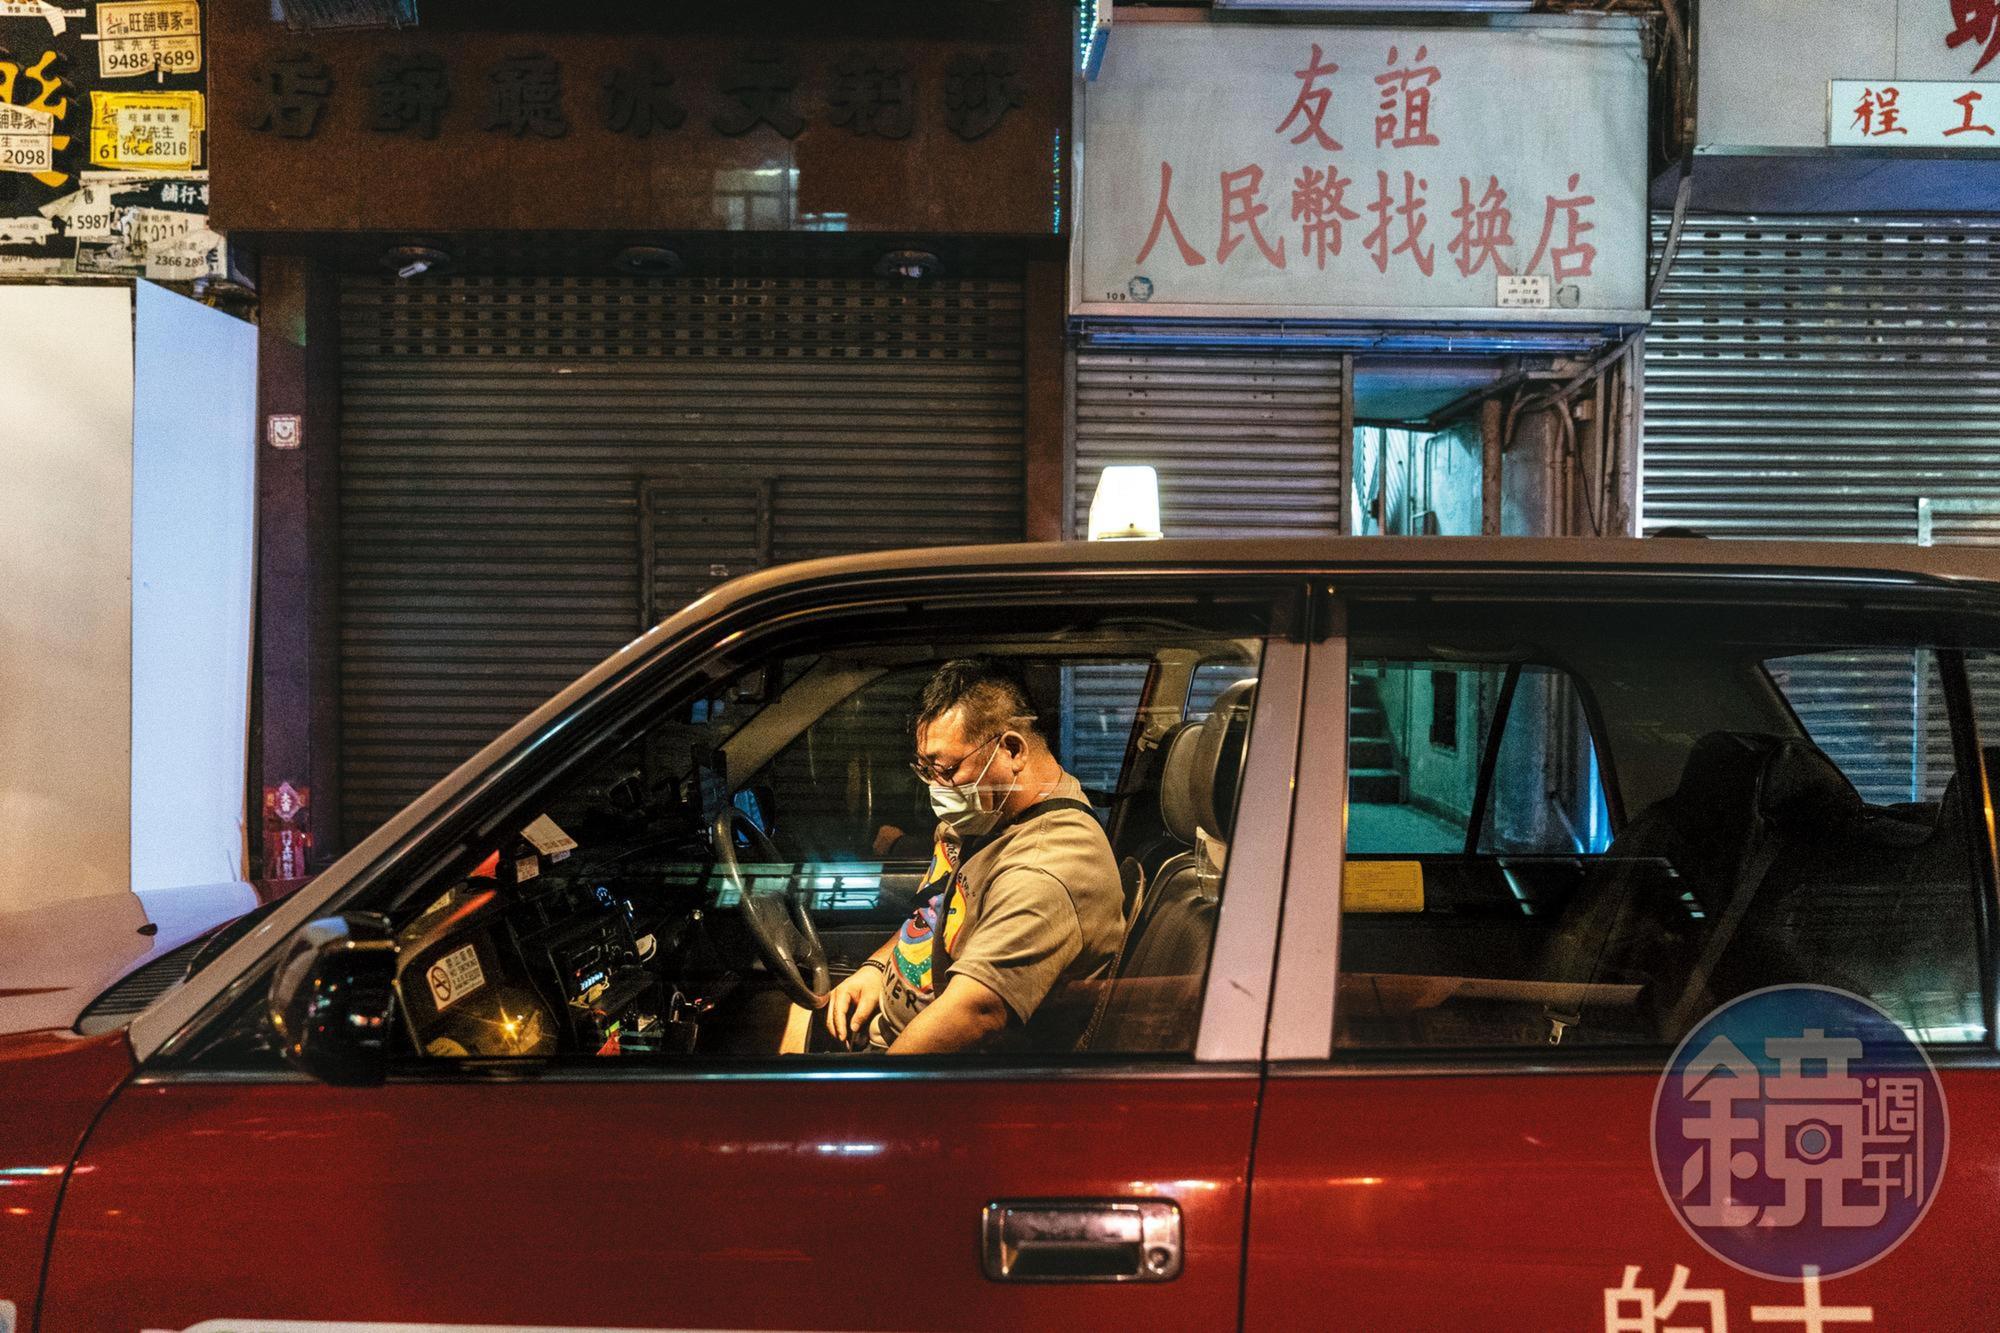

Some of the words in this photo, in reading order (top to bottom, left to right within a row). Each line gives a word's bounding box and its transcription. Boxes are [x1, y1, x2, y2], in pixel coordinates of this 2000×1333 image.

[109, 52, 149, 69] 9488
[1275, 43, 1442, 151] 友誼
[4, 149, 46, 165] 2098
[77, 214, 108, 230] 5987
[155, 254, 182, 268] 2366
[1106, 292, 1127, 301] 109
